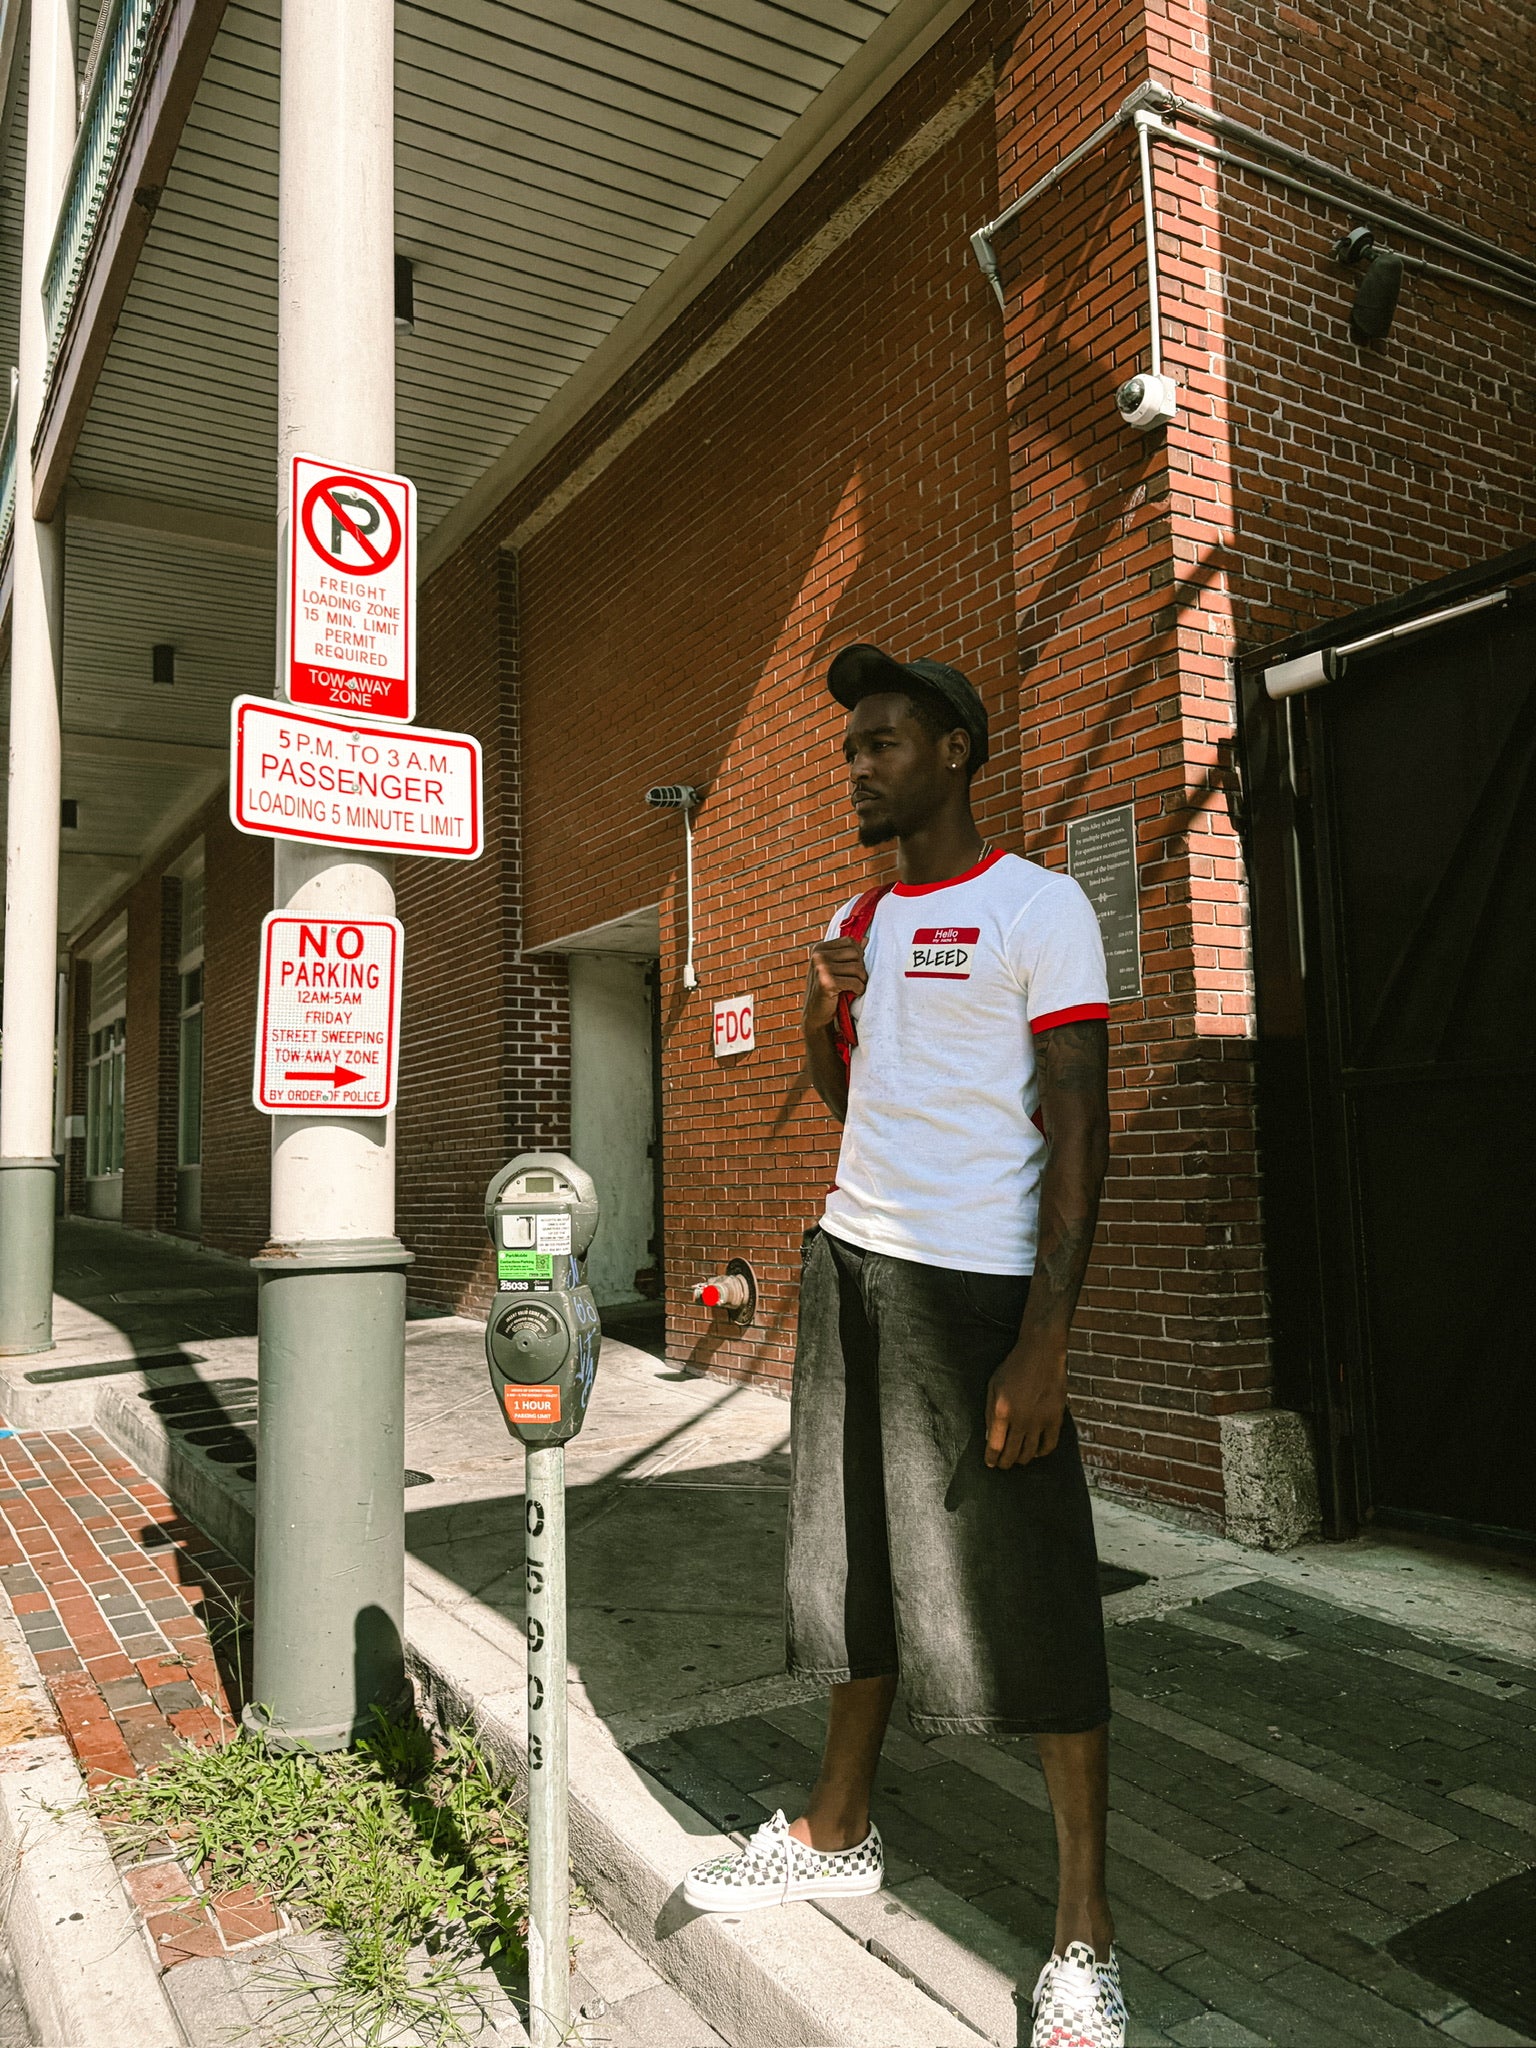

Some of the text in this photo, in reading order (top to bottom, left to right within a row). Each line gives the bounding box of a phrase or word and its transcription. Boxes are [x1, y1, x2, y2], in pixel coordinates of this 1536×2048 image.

[320, 576, 387, 601] FREIGHT
[302, 589, 400, 620] LOADING ZONE
[304, 607, 399, 636] 15 MIN. LIMIT
[325, 628, 376, 650] PERMIT
[314, 643, 388, 667] REQUIRED
[308, 669, 392, 696] TOW-AWAY
[329, 688, 372, 707] ZONE
[279, 729, 453, 775] 5 P.M. TO 3 A.M.
[261, 753, 444, 805] PASSENGER
[249, 788, 464, 837] LOADING 5 MINUTE LIMIT
[299, 925, 364, 960] NO
[934, 929, 959, 938] Hello
[912, 948, 968, 968] BLEED
[281, 961, 379, 989] PARKING
[298, 990, 362, 1005] 12AM-5AM
[305, 1011, 352, 1025] FRIDAY
[715, 1007, 752, 1046] FDC
[272, 1029, 384, 1044] STREET SWEEPING
[275, 1048, 379, 1064] TOW-AWAY ZONE
[269, 1090, 284, 1100] BY
[288, 1090, 323, 1101] ORDER
[343, 1090, 381, 1103] POLICE
[500, 1282, 529, 1291] 25033
[514, 1401, 552, 1410] 1 HOUR
